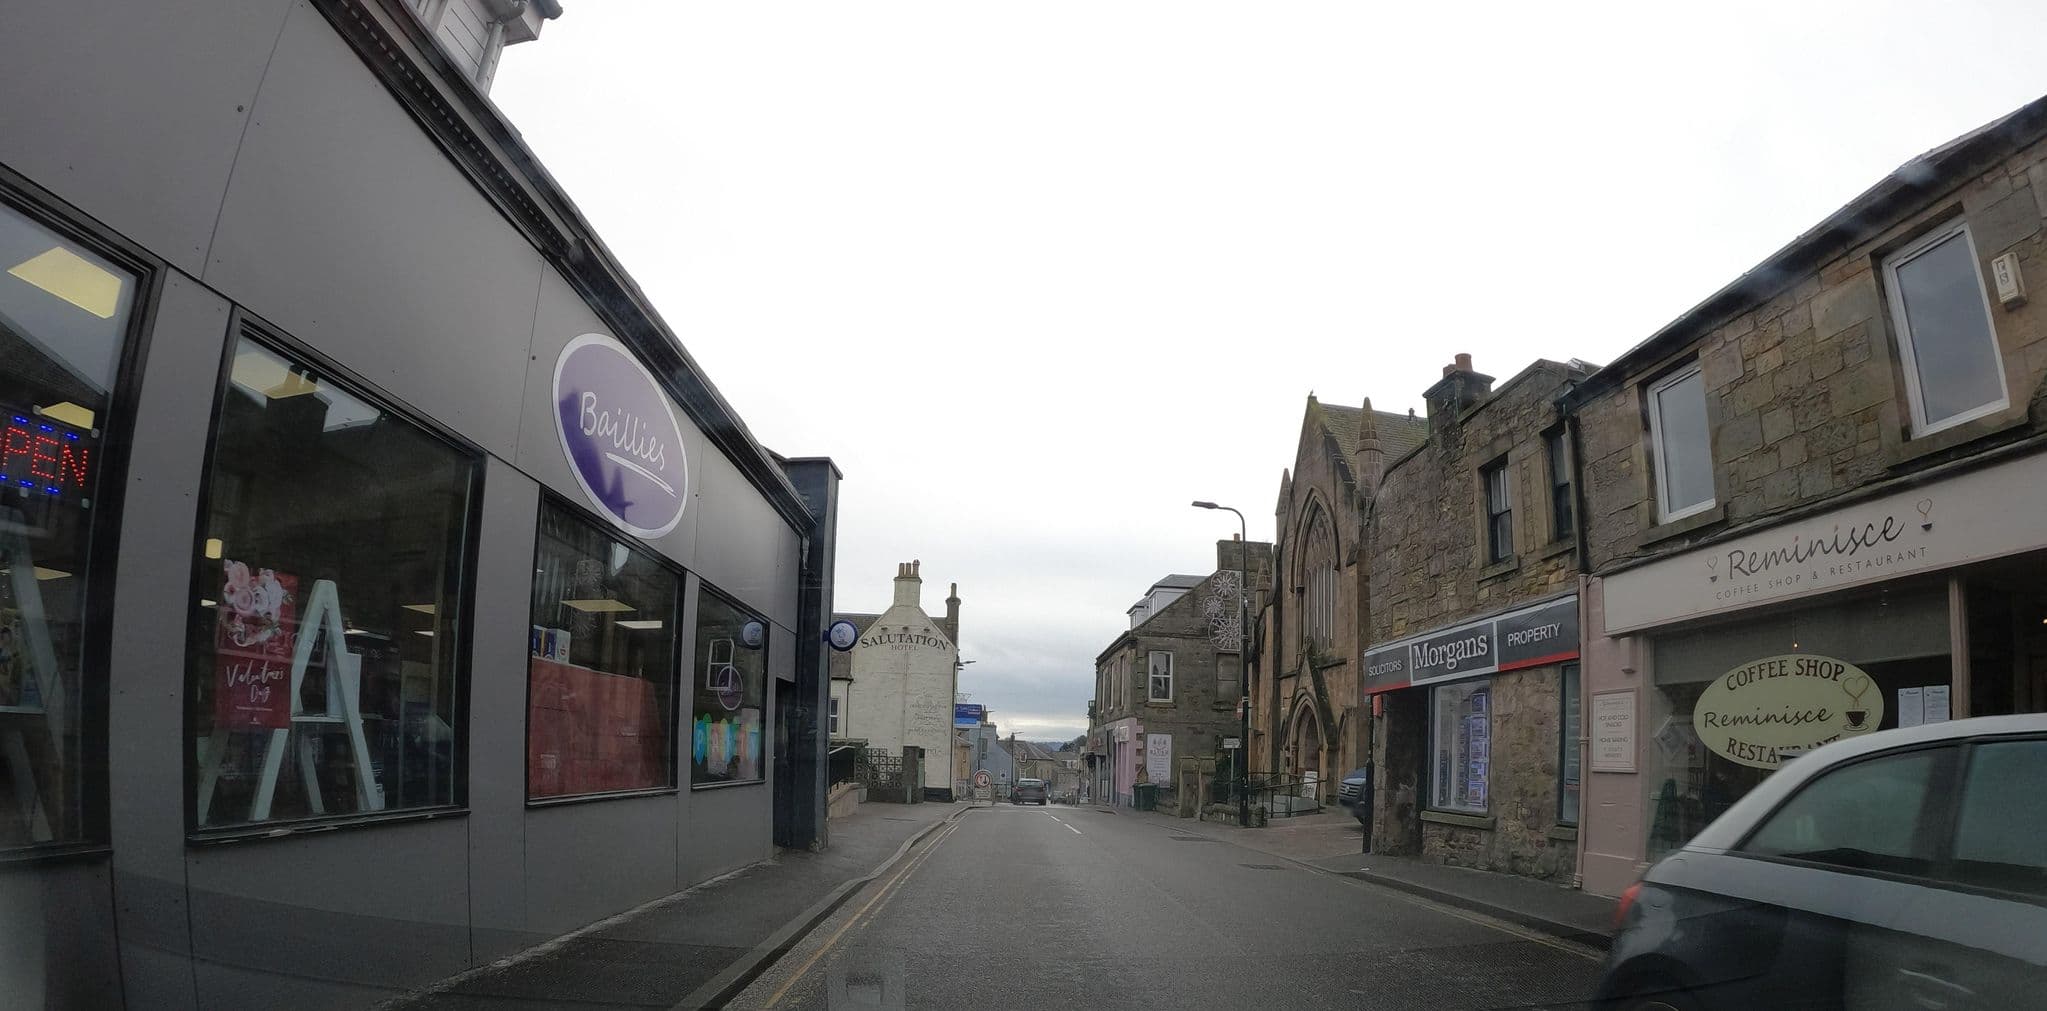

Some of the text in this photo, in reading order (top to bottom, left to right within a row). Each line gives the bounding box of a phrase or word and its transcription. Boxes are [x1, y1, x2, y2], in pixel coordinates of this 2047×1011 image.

[0, 425, 89, 488] PEN
[580, 391, 665, 472] Baillies
[1716, 547, 1928, 600] COFFEE SHOP & RESTAURANT
[1728, 515, 1906, 580] Reminisce
[861, 633, 949, 651] SALUTATION
[1368, 624, 1561, 677] SOLICITORS Morgans PROPERTY
[1726, 658, 1845, 691] COFFEE SHOP
[1704, 704, 1834, 728] Reminisce
